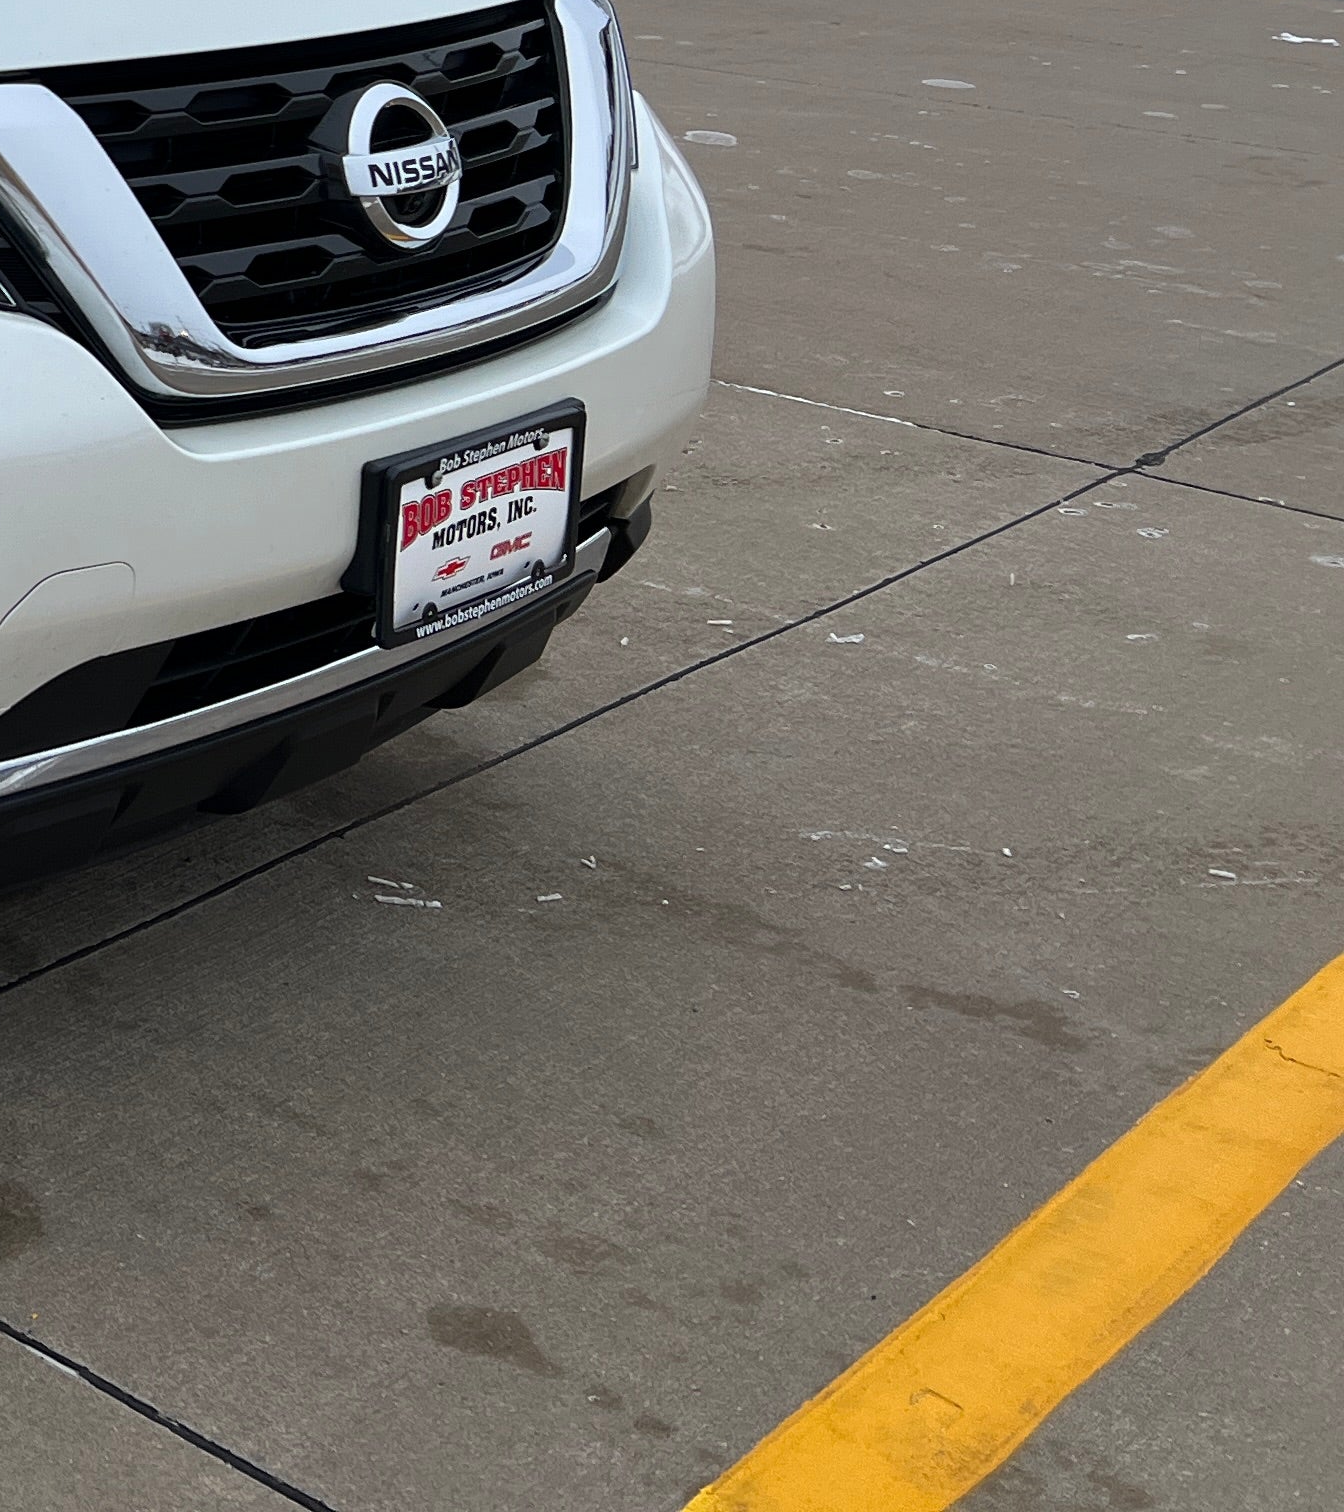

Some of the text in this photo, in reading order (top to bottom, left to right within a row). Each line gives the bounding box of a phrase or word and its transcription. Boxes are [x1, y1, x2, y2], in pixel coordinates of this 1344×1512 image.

[367, 149, 460, 188] NISSAN
[439, 428, 545, 473] Bob Stephen Motors
[400, 447, 568, 552] BOB STEPHEN
[432, 495, 537, 550] MOTORS, INC.
[489, 531, 532, 560] GMC
[416, 575, 553, 638] www.bobstephenmotors.com
